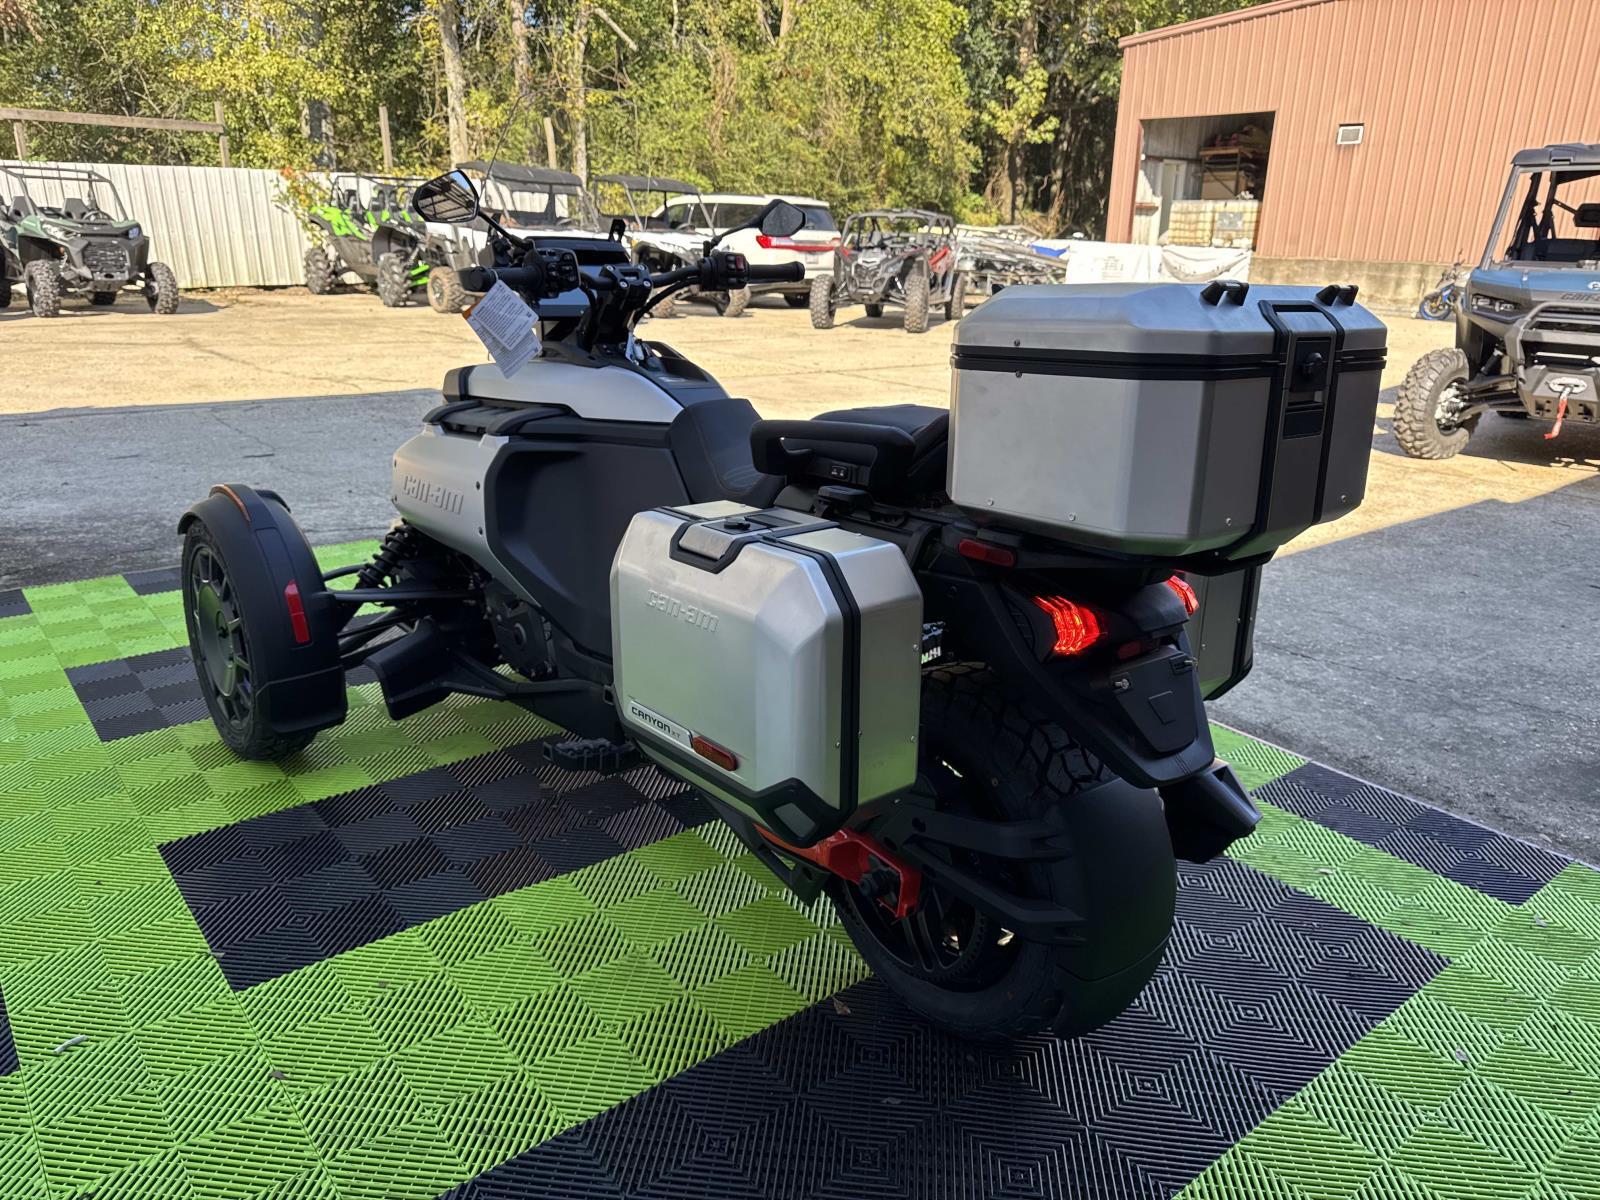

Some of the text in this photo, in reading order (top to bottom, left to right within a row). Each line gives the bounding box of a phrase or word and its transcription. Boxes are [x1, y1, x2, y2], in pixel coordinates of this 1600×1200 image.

[403, 475, 464, 515] can-am
[647, 589, 719, 632] can-am
[631, 706, 671, 734] CANYON
